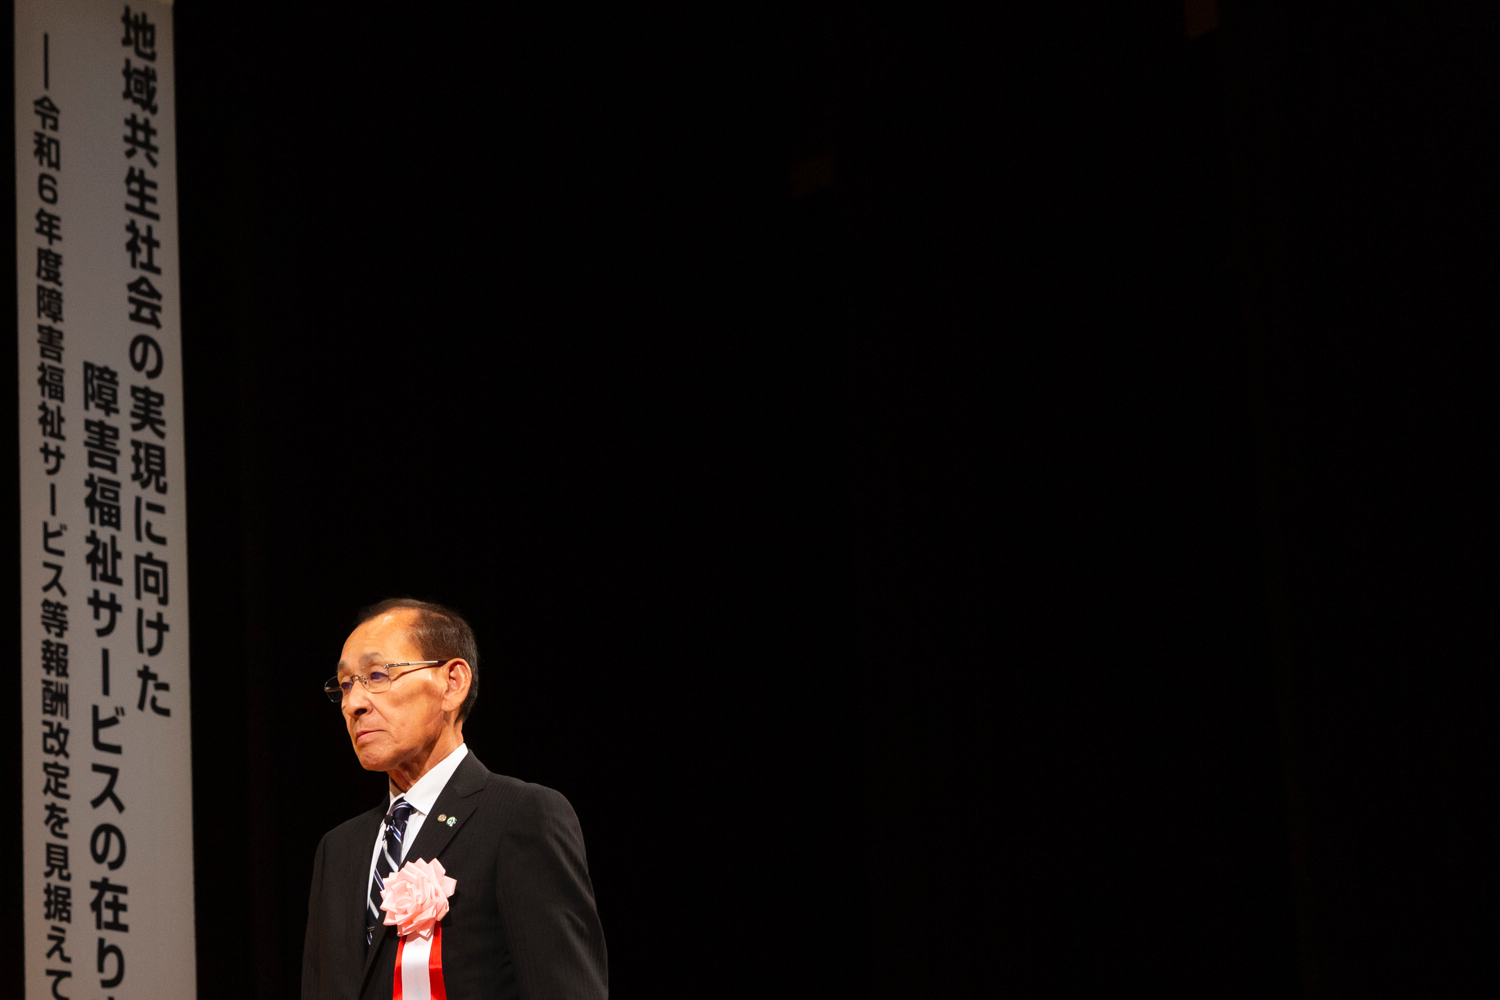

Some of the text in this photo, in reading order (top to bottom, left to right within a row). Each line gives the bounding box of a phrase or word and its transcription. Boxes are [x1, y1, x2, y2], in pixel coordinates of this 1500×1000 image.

[120, 4, 172, 718] 地域共生社会の実現に向けた
